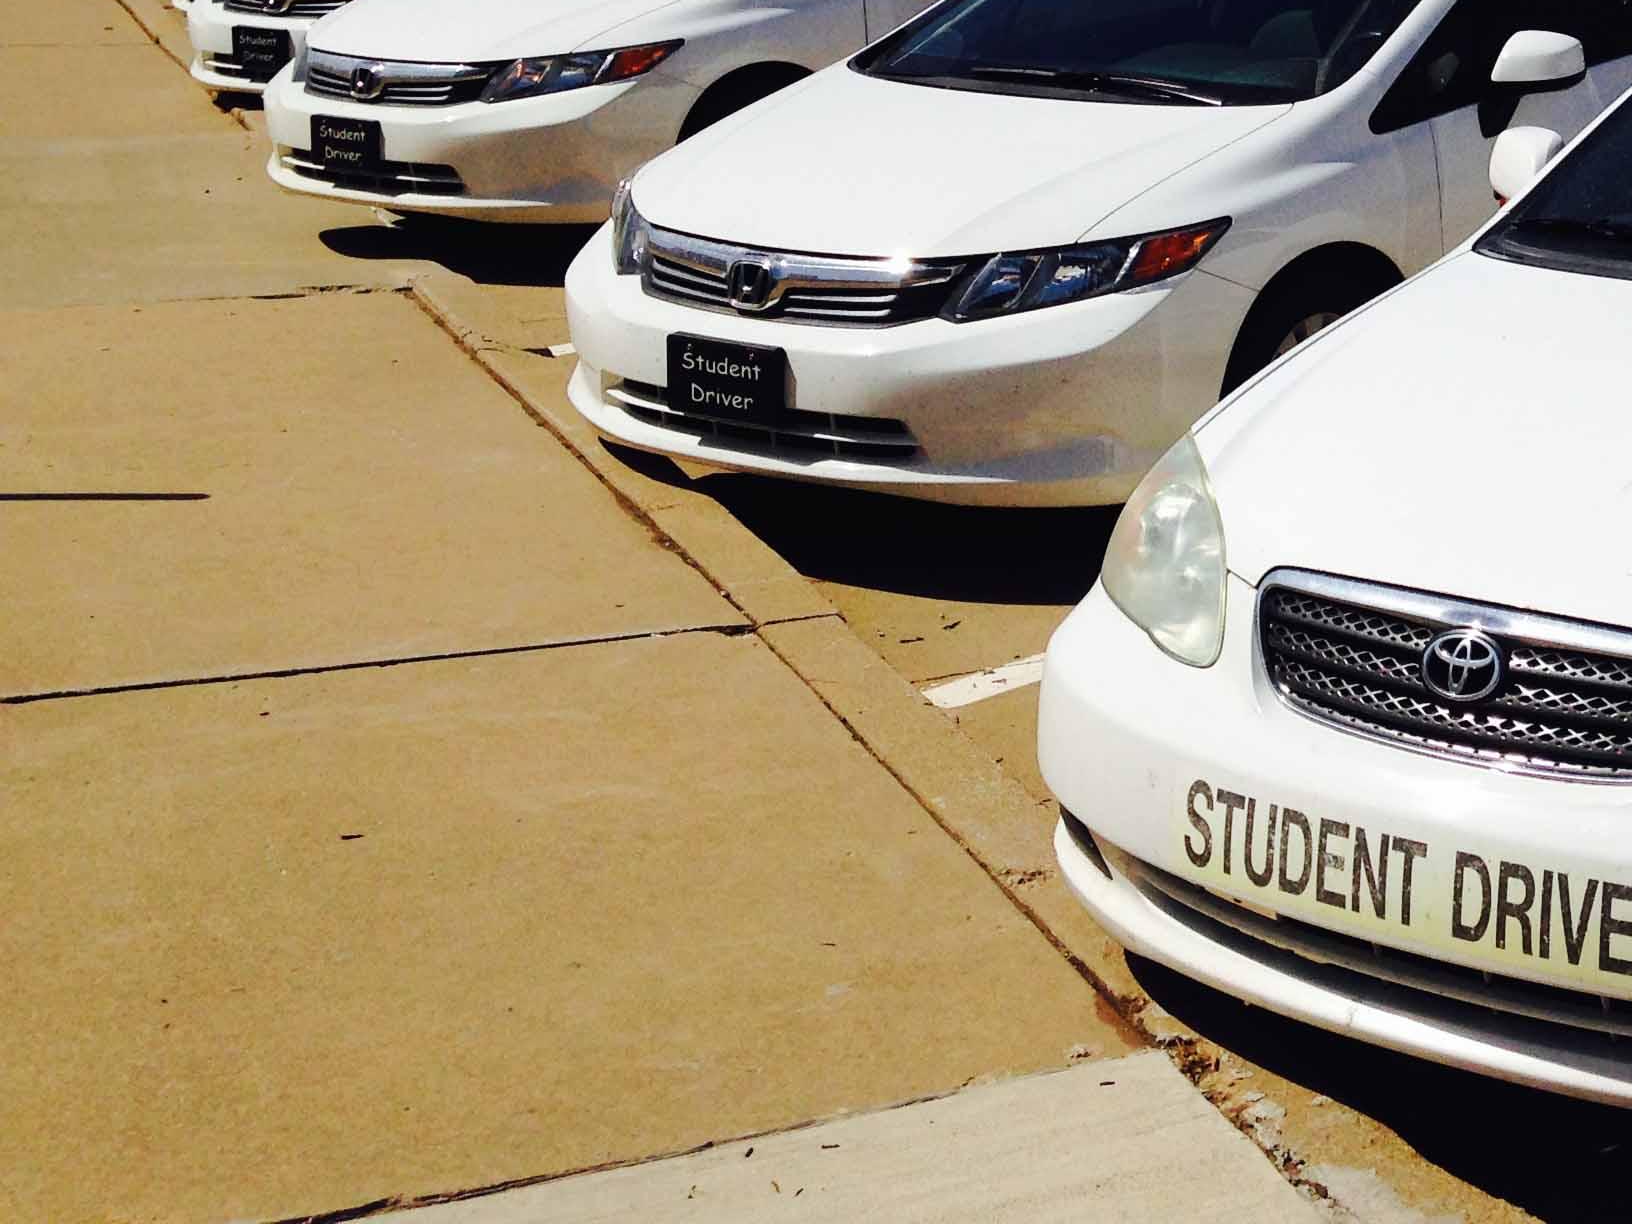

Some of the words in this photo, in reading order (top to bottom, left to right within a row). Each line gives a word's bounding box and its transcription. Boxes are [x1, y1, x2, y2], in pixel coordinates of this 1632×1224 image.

[319, 124, 366, 142] Student
[325, 144, 361, 161] Driver
[681, 352, 761, 381] Student
[690, 382, 754, 410] Driver
[1184, 778, 1428, 927] STUDENT
